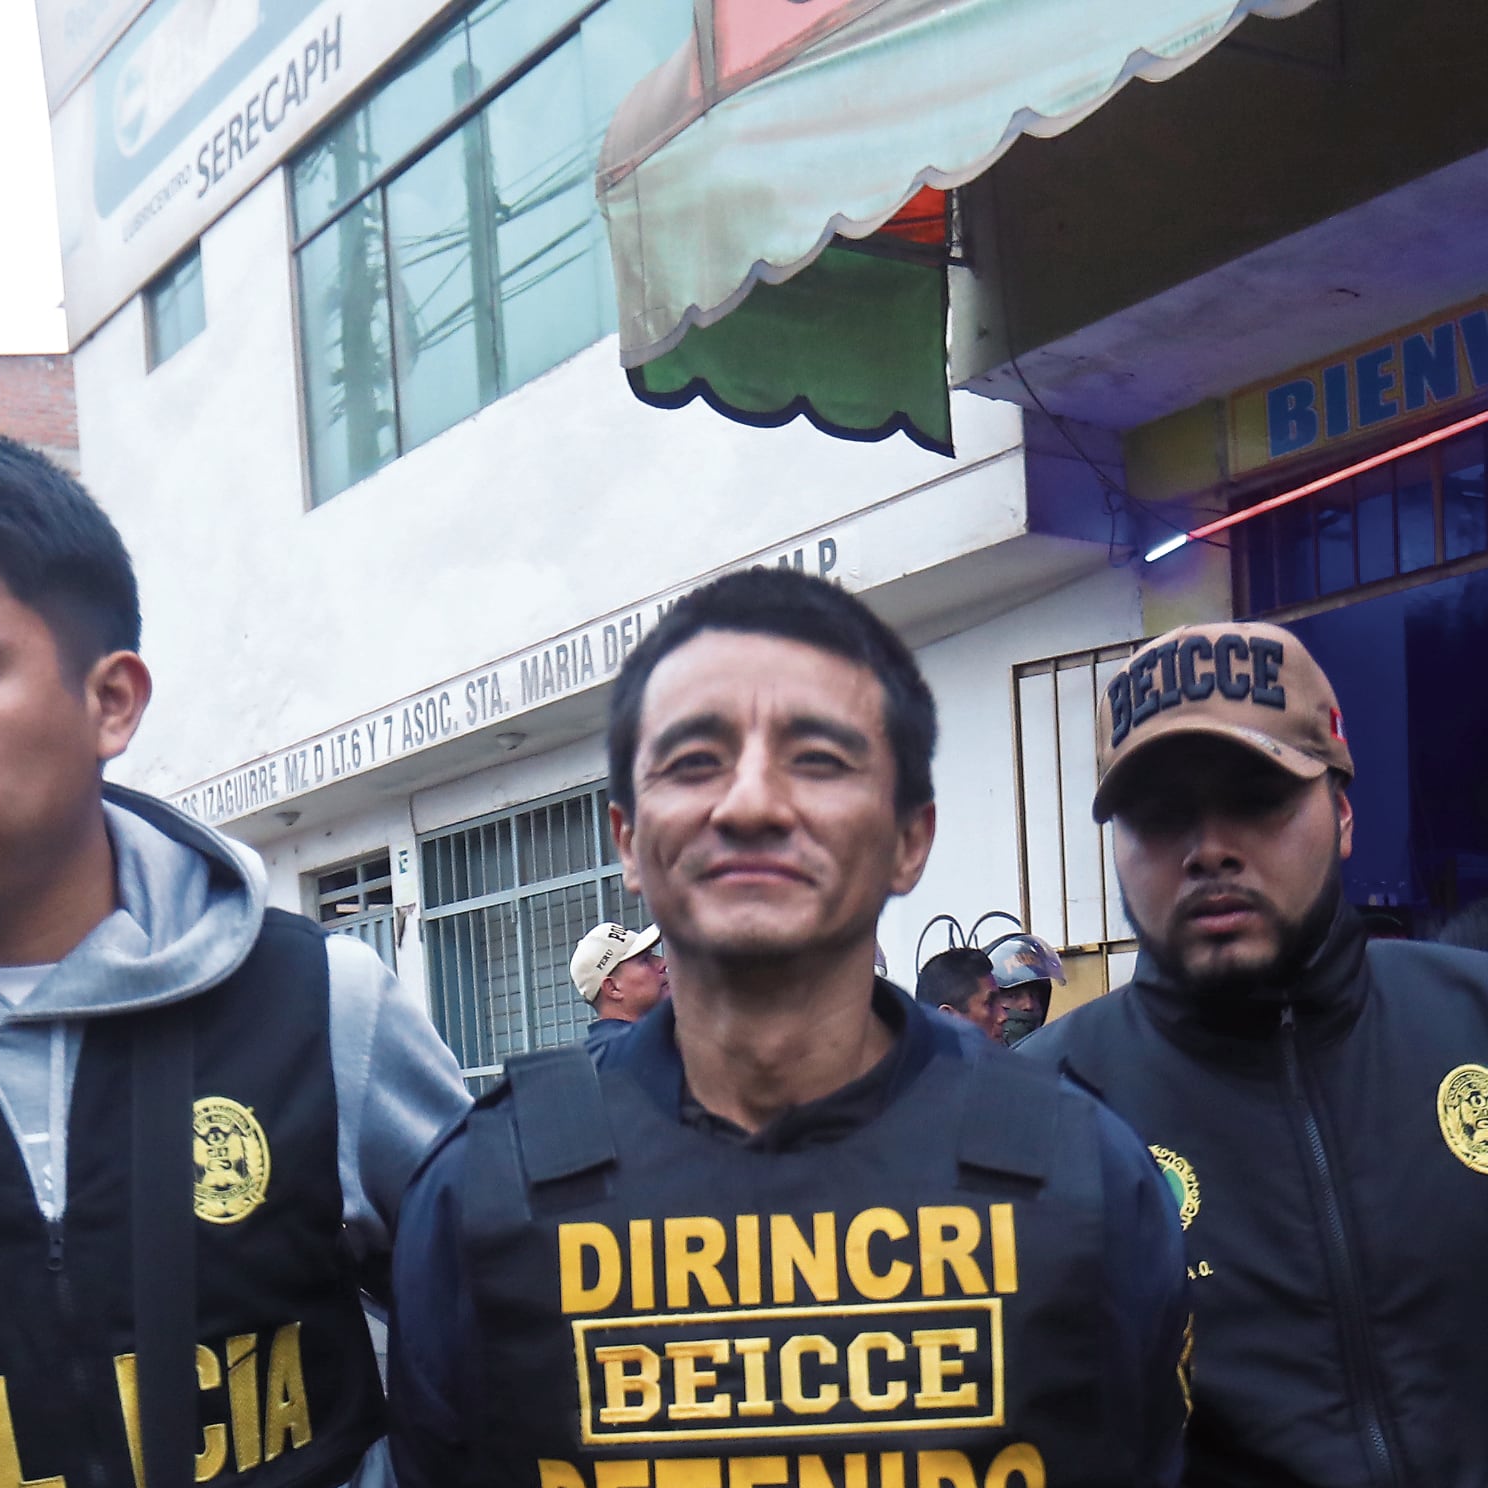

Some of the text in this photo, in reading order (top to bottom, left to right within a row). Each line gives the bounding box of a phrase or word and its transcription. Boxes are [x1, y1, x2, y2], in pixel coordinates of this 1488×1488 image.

[196, 12, 341, 199] SERECAPH
[201, 760, 278, 822] IZAGUIRRE
[284, 749, 310, 793] MZ
[314, 744, 324, 781] D
[330, 728, 362, 778] LT.6
[366, 720, 379, 762] Y
[383, 715, 394, 756] 7
[402, 691, 459, 751] ASOC.
[465, 671, 510, 726] STA.
[520, 634, 595, 706] MARIA
[1107, 633, 1287, 748] BEICCE
[596, 949, 615, 970] PERU
[558, 1203, 1018, 1313] DIRINCRI
[595, 1328, 978, 1424] BEICCE
